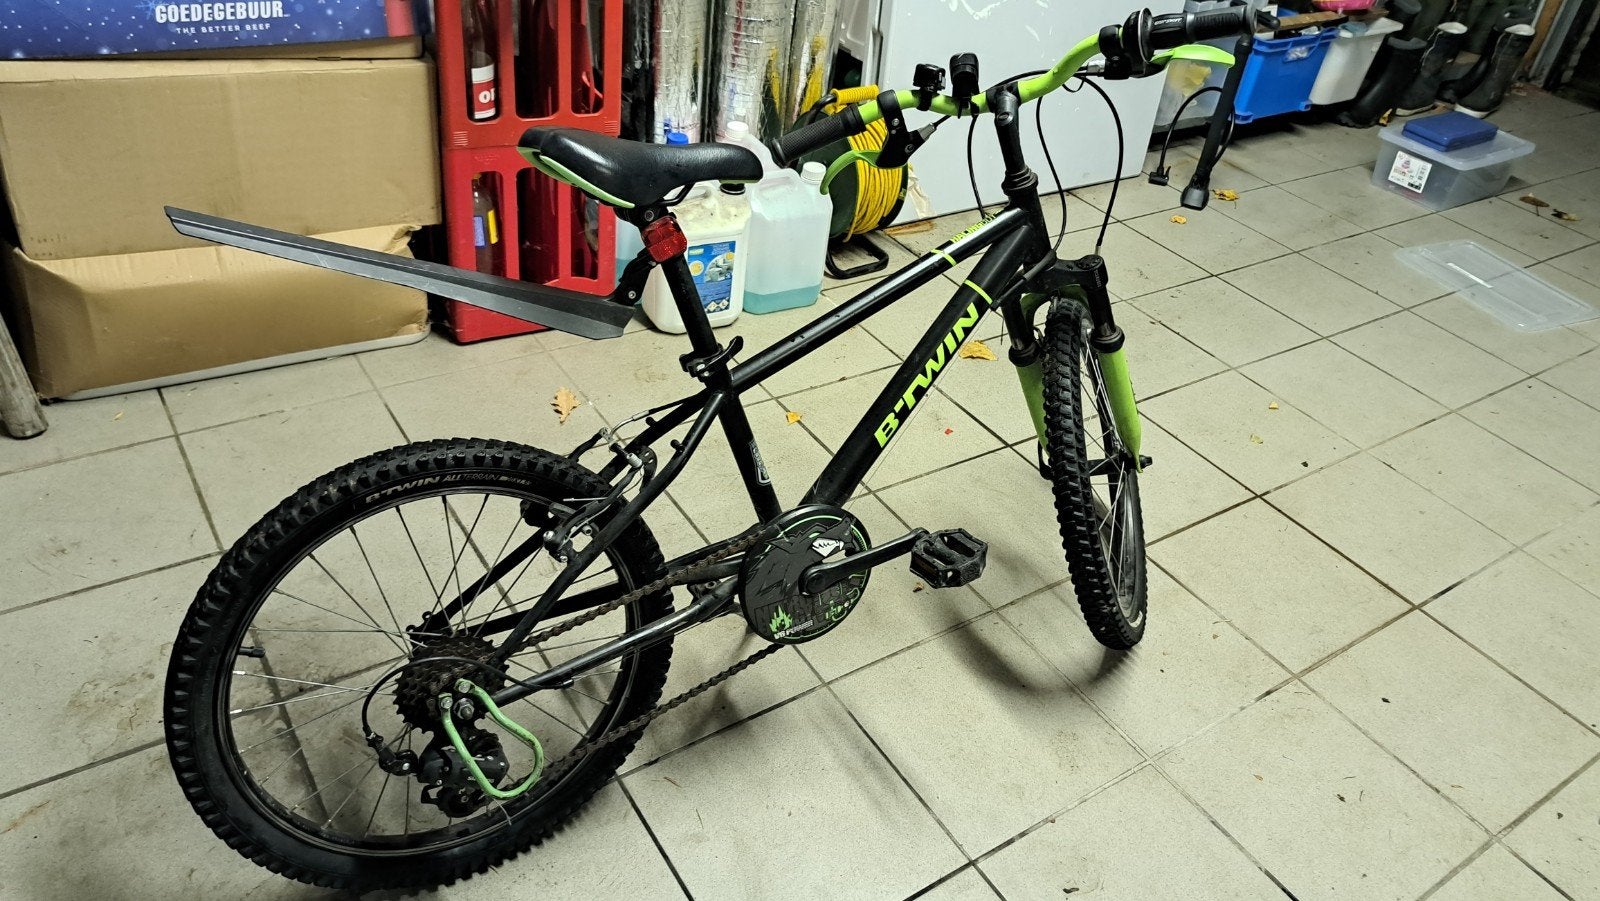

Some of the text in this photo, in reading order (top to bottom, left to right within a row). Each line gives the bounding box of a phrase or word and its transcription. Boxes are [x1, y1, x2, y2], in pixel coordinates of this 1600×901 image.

[155, 1, 284, 23] GOEDEGEBUUR
[201, 25, 240, 33] BETTER
[245, 23, 271, 31] BEEF
